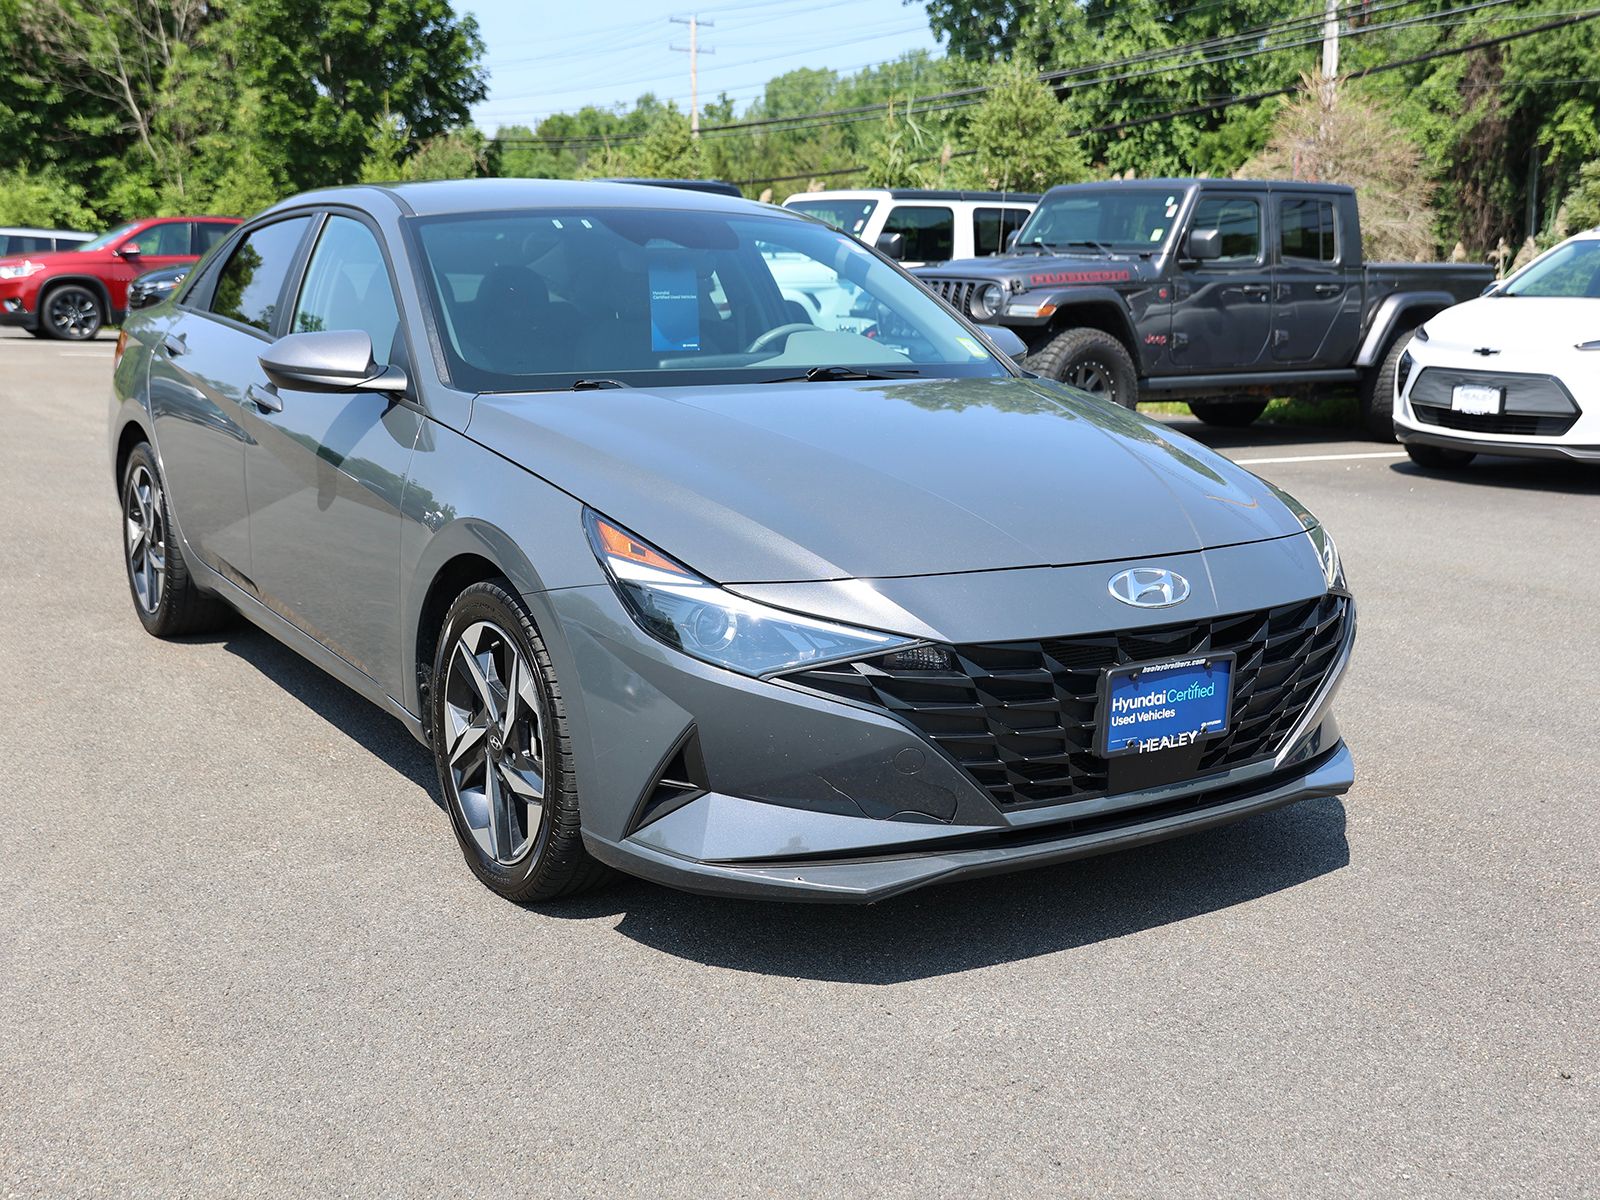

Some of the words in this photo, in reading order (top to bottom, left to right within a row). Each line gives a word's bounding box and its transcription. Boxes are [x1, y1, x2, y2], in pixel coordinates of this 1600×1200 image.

[1030, 270, 1129, 285] RUBICON
[1145, 332, 1167, 345] Jeep
[1142, 658, 1206, 673] healeybrothers.com
[1112, 690, 1166, 712] Hyundai
[1167, 681, 1215, 703] Certified
[1111, 713, 1136, 727] Used
[1137, 708, 1176, 722] Vehicles
[1138, 730, 1198, 754] HEALEY
